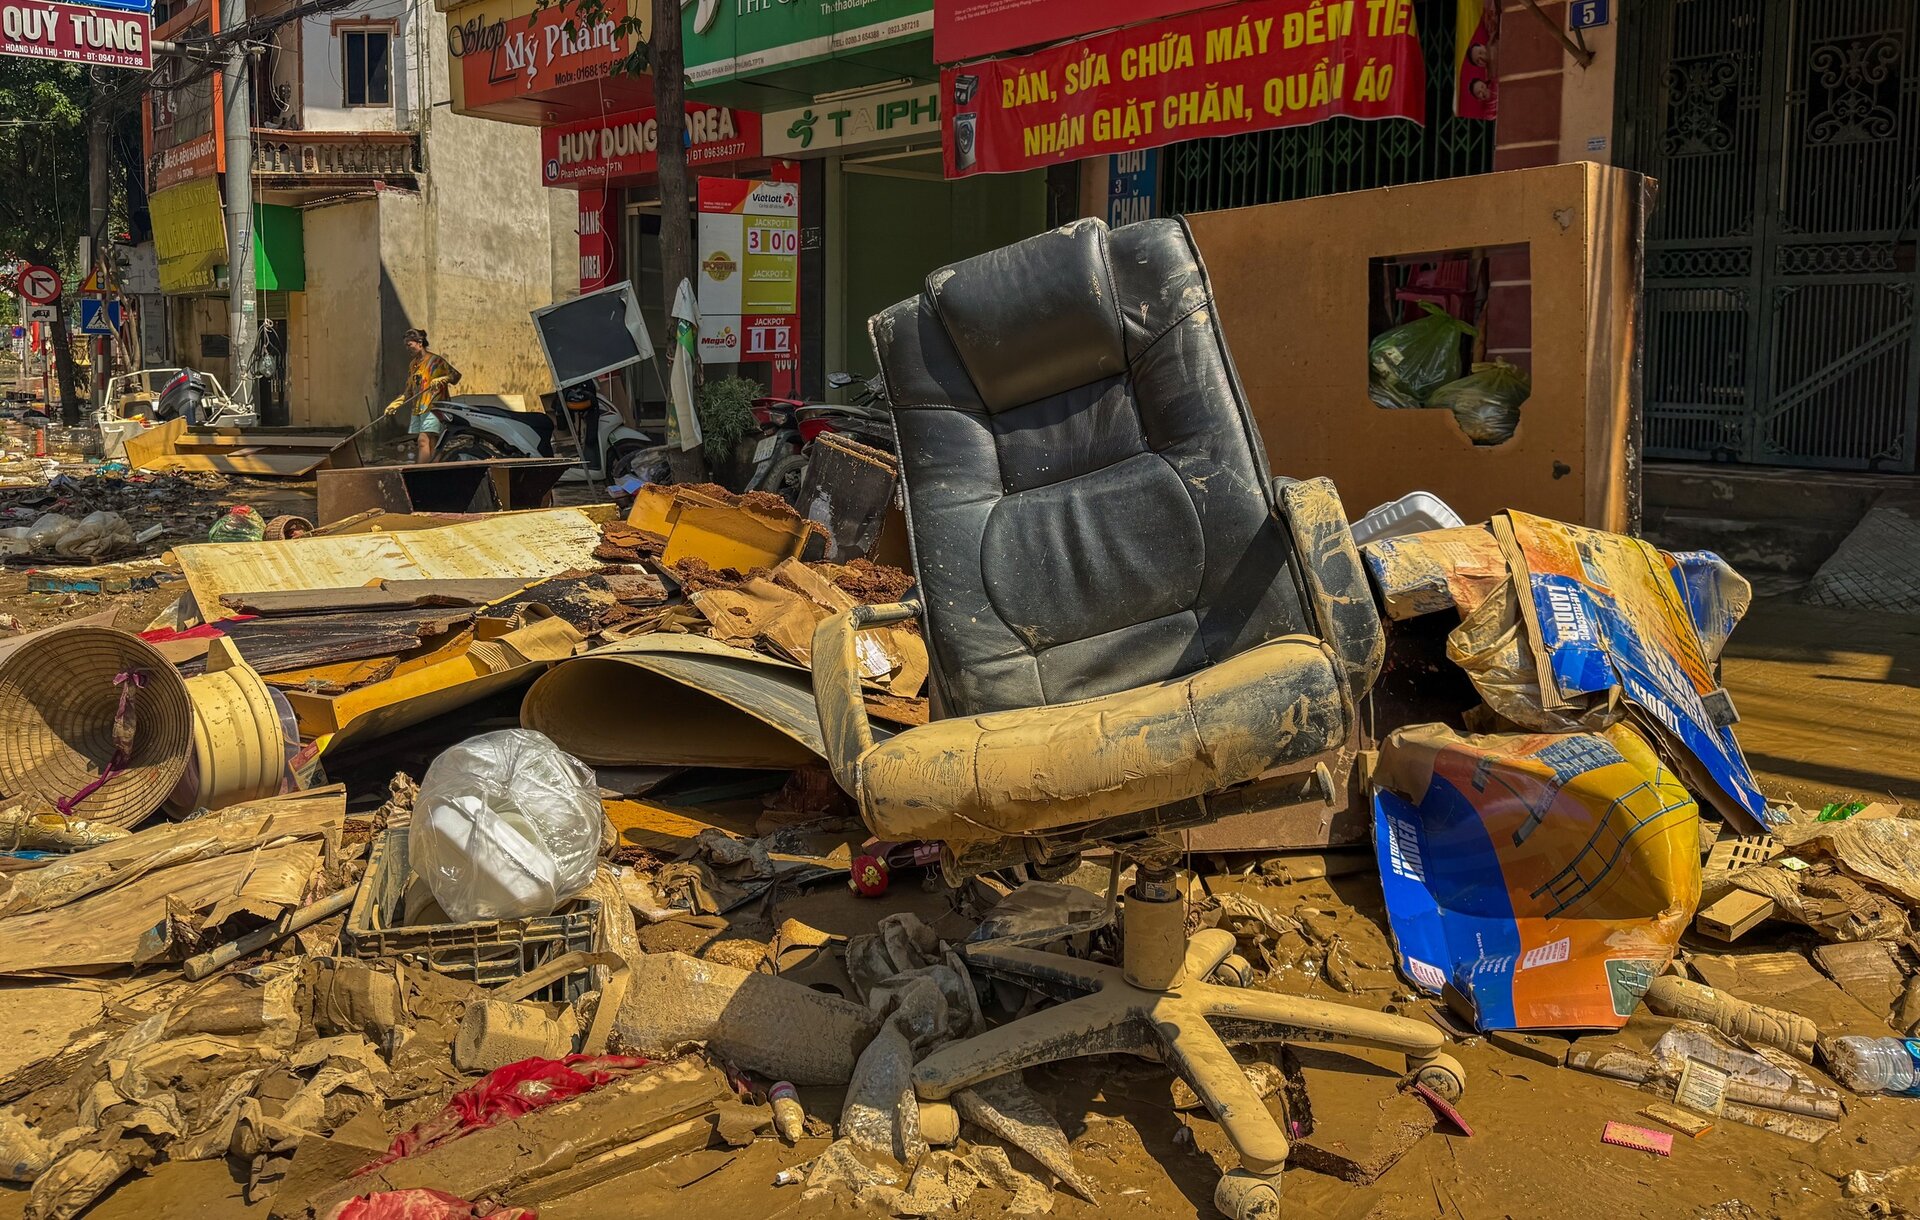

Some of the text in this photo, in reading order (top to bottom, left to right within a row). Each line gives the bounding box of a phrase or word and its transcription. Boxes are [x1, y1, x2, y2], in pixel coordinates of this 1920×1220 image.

[1583, 2, 1595, 24] 5
[3, 5, 142, 52] QUÝ TÙNG
[64, 49, 80, 59] TPTN
[98, 54, 115, 63] 0947
[117, 56, 124, 64] 11
[124, 57, 133, 65] 22
[134, 57, 143, 66] 88
[449, 14, 514, 80] Shop
[505, 11, 620, 90] Mỹ Phẩm
[1002, 68, 1057, 109] BÁN,
[1065, 48, 1111, 95] SỬA
[1121, 32, 1194, 82] CHỮA
[1205, 16, 1273, 65] MÁY
[1024, 57, 1393, 157] NHẬN GIẶT CHĂN, QUẦN ÁO
[559, 128, 597, 165] HUY
[601, 118, 658, 159] DUNG
[547, 161, 558, 178] 1A
[1115, 179, 1122, 194] 3
[752, 193, 782, 204] Vietlott
[1111, 188, 1150, 228] CHĂN
[754, 219, 785, 227] JACKPOT
[749, 231, 760, 249] 3
[580, 255, 601, 279] KOREA
[752, 269, 784, 278] JACKPOT
[754, 318, 785, 326] JACKPOT
[701, 337, 725, 346] Mega
[1547, 585, 1579, 641] LADDER
[1397, 819, 1426, 883] LADDER
